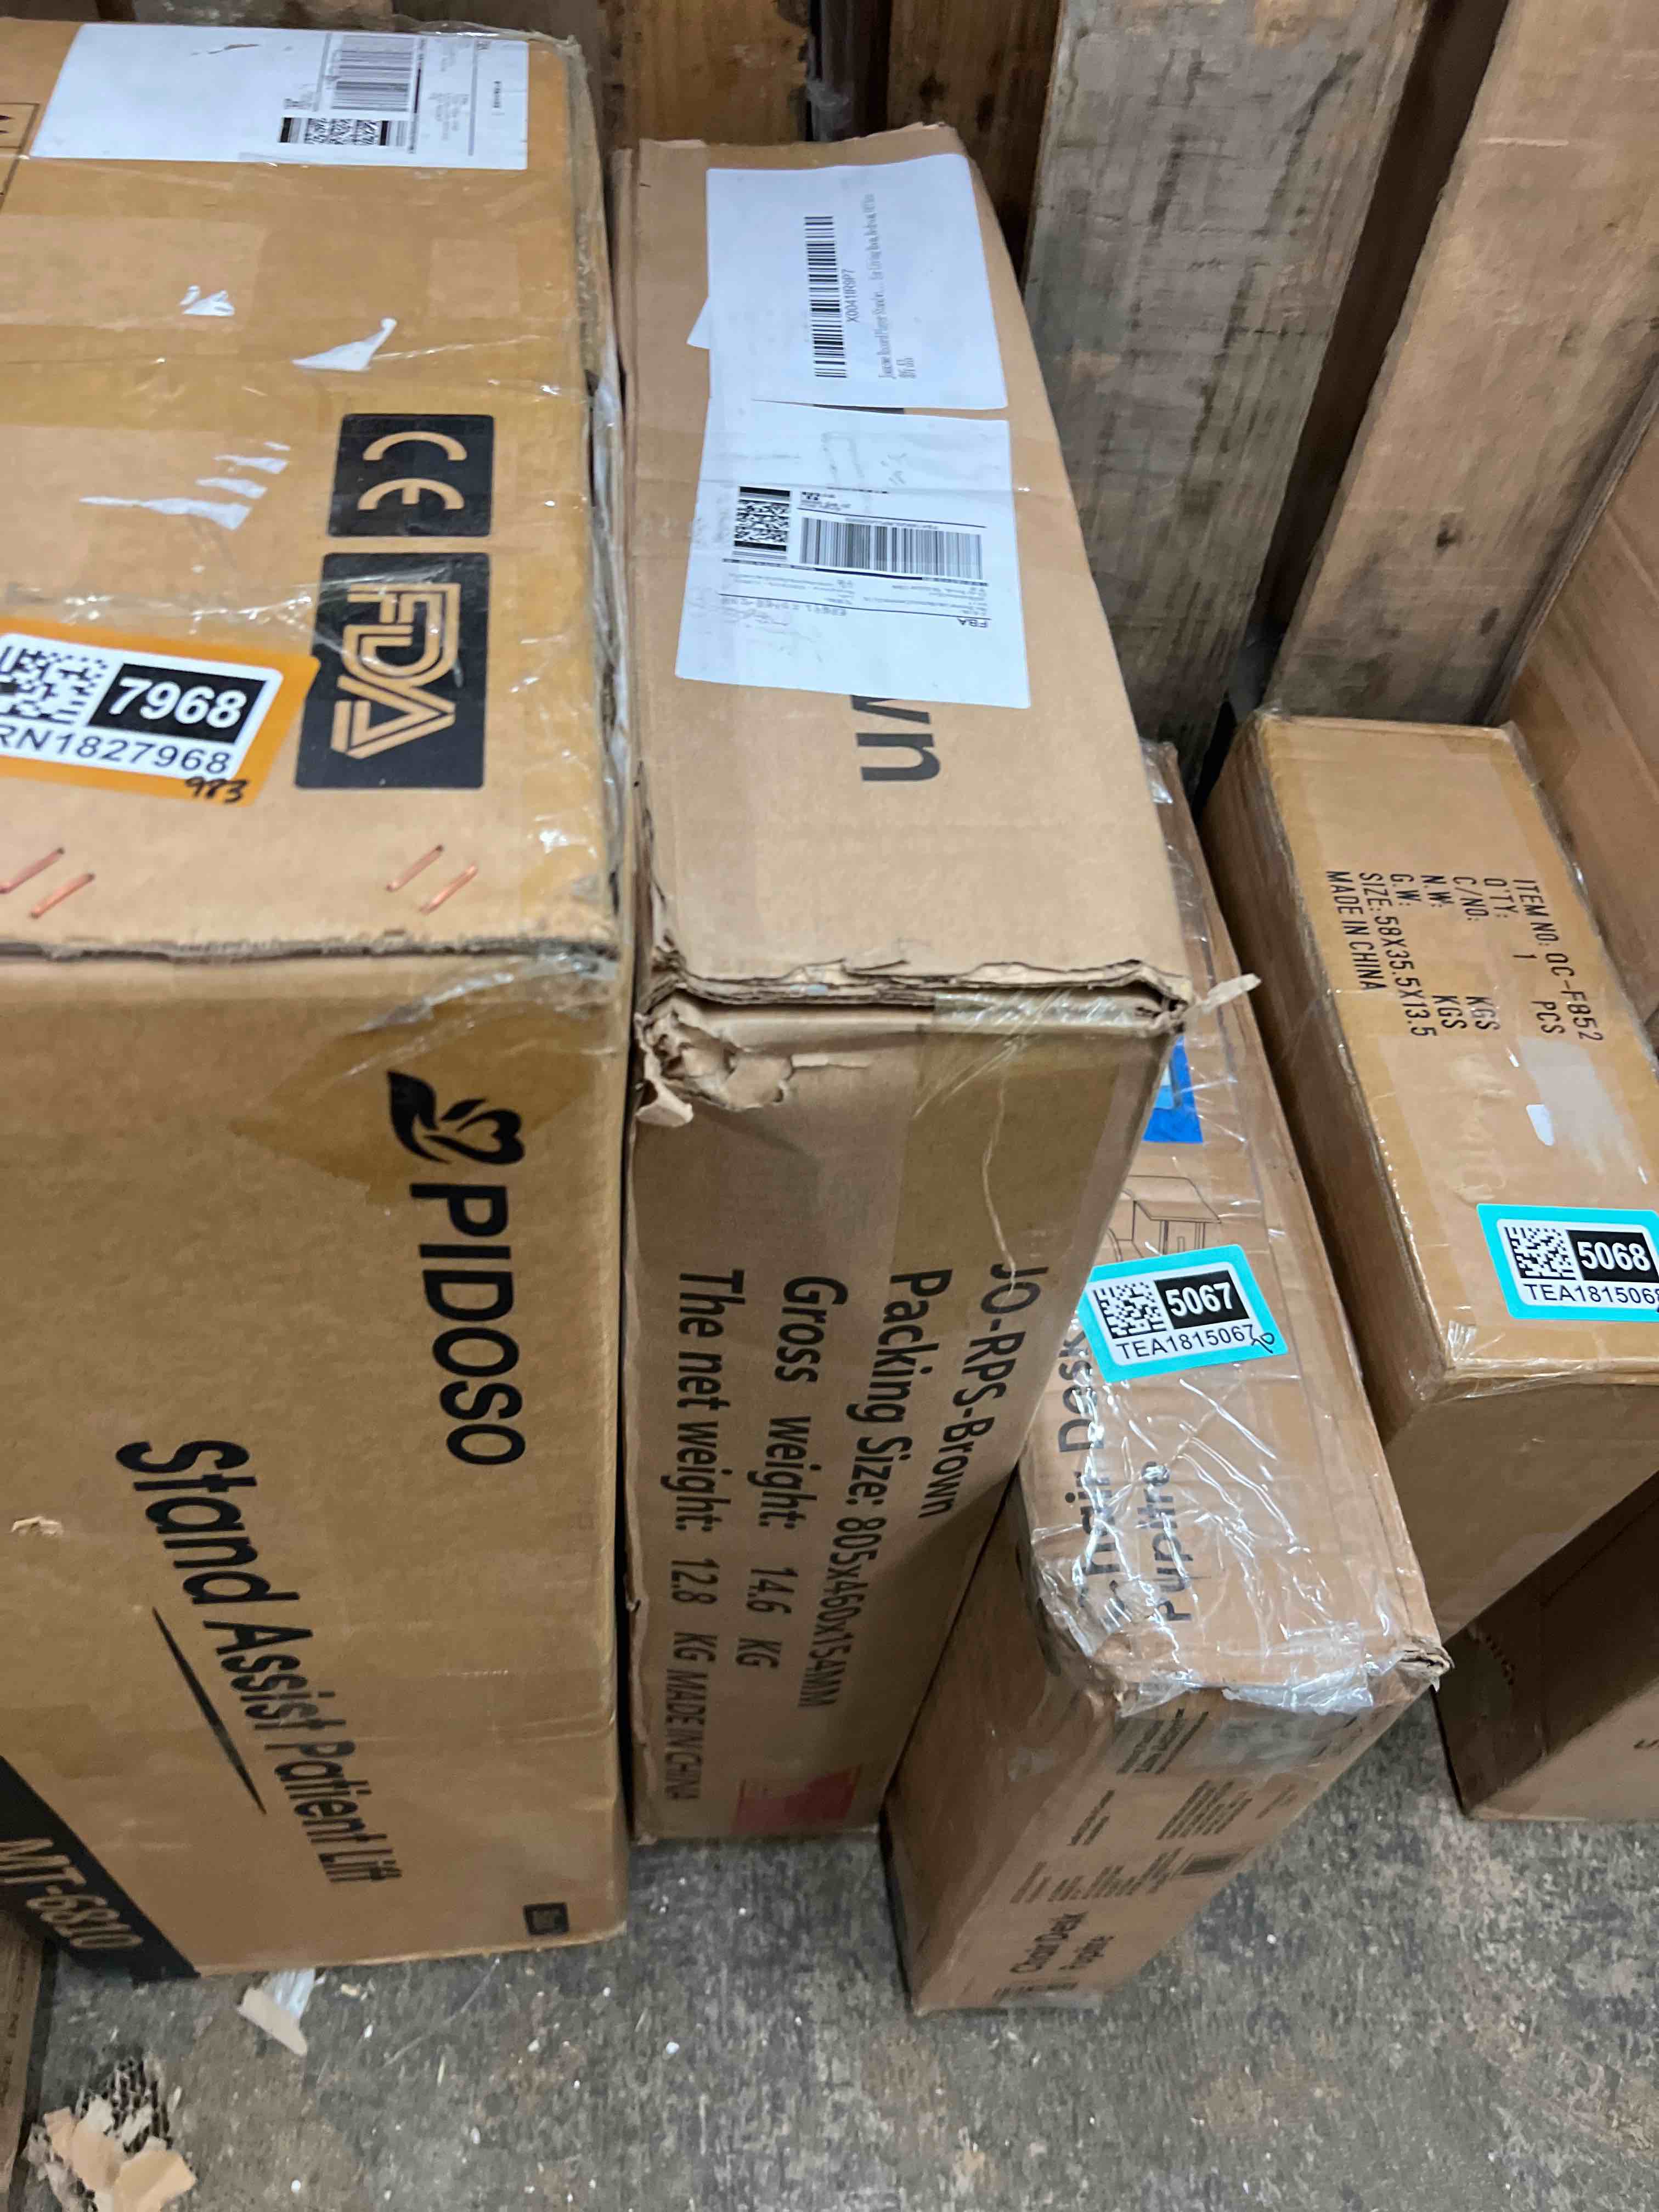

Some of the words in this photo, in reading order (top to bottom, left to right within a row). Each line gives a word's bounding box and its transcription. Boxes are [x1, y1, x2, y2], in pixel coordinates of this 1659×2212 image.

[358, 431, 467, 510] CE
[958, 617, 989, 628] FBA
[331, 583, 462, 759] FDA
[109, 676, 247, 729] 7968
[0, 724, 232, 774] RN1827968
[1326, 871, 1364, 915] MADE
[1453, 877, 1489, 921] C/NO:
[1513, 879, 1549, 917] ITEM
[1531, 922, 1559, 945] NO:
[1341, 921, 1370, 935] IN
[1348, 941, 1387, 991] CHINA
[1432, 995, 1468, 1029] KGS
[1465, 996, 1501, 1030] KGS
[1531, 1001, 1566, 1034] PCS
[1577, 1240, 1651, 1272] 5068
[409, 1183, 526, 1465] PIDOSO
[678, 1268, 747, 1339] The
[1165, 1282, 1233, 1317] 5067
[774, 1276, 849, 1384] Gross
[846, 1268, 953, 1424] Packing
[1116, 1324, 1255, 1359] TEA1815067
[676, 1348, 732, 1410] net
[919, 1263, 1049, 1519] JO-RPS-Brown
[660, 1421, 733, 1533] weight:
[747, 1415, 822, 1531] weight:
[848, 1435, 913, 1509] Size:
[116, 1440, 300, 1606] Stand
[670, 1556, 721, 1606] 12.8
[746, 1565, 799, 1617] 14.6
[673, 1631, 719, 1663] KG
[736, 1637, 783, 1669] KG
[203, 1619, 347, 1730] Assist
[264, 1738, 388, 1843] Patient
